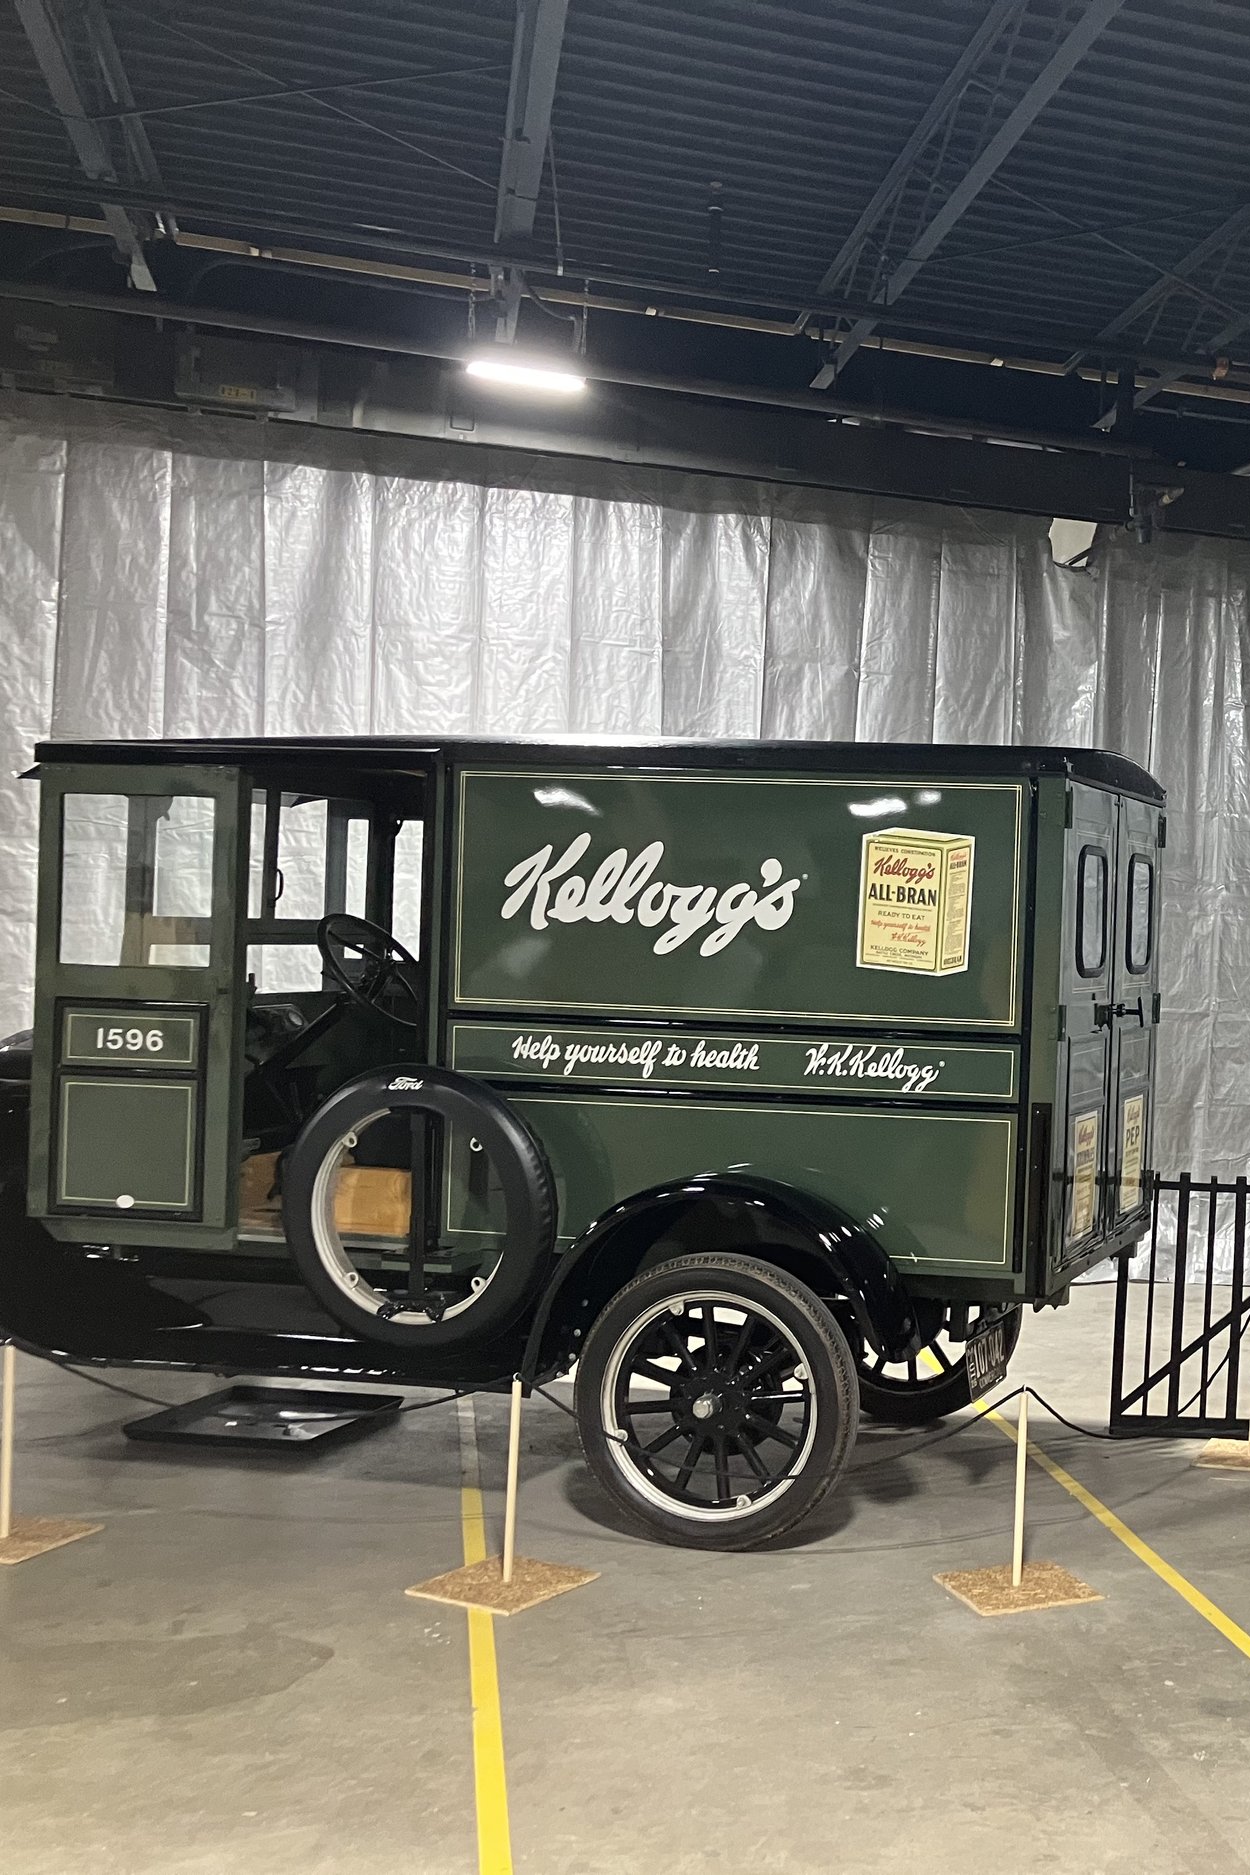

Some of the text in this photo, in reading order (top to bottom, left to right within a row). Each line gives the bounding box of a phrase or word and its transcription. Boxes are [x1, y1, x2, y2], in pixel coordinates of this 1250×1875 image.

[873, 855, 936, 885] Kellogg's
[501, 832, 800, 957] Kellogg's
[868, 883, 937, 907] ALL-BRAN
[878, 910, 901, 919] READY
[902, 912, 911, 920] TO
[870, 944, 929, 957] KELLOGG COMPANY
[97, 1028, 164, 1051] 1596
[512, 1035, 760, 1079] Help yourself to health
[388, 1076, 424, 1091] Ford
[1126, 1125, 1140, 1149] PEP
